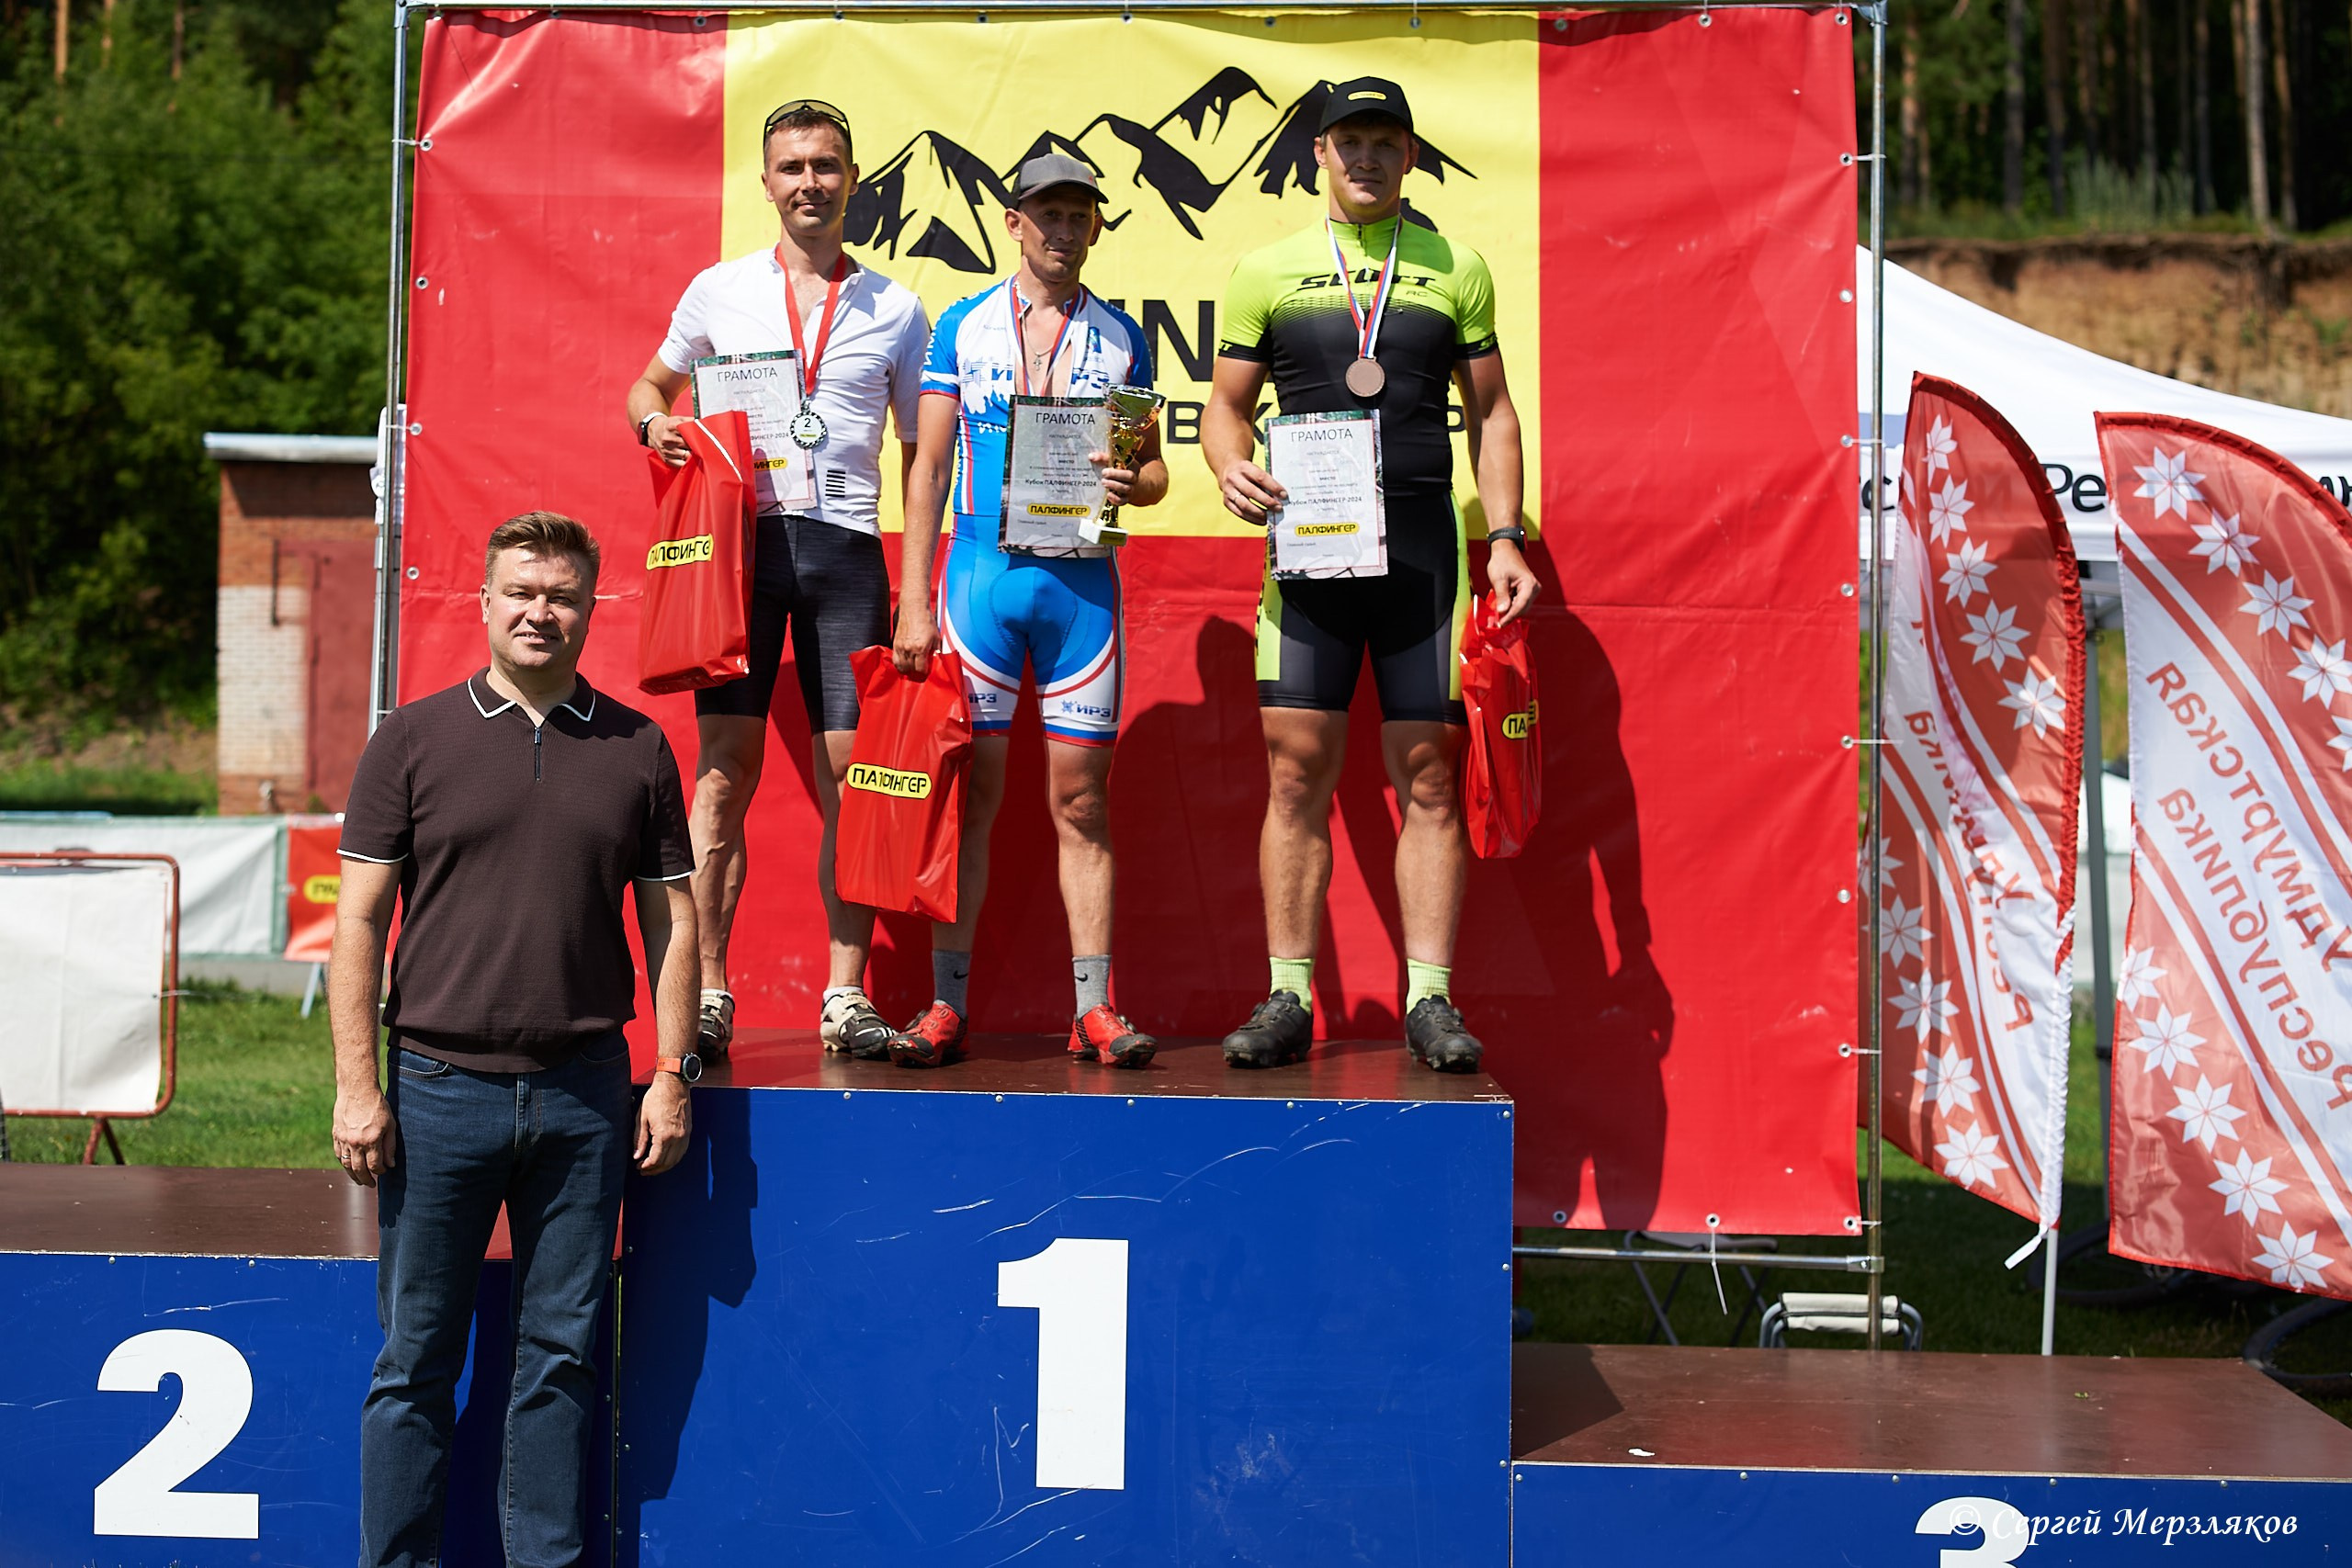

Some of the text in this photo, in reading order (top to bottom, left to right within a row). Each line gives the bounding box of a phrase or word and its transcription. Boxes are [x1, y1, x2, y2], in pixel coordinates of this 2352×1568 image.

[718, 367, 777, 382] ГРАМОТА
[804, 417, 811, 428] 2
[1035, 412, 1096, 425] ГРАМОТА
[1291, 428, 1353, 443] ГРАМОТА
[1030, 505, 1088, 515] ПАЛФИНГЕР
[1297, 524, 1356, 535] ПАЛФИНГЕР
[1077, 704, 1112, 718] ИРЗ
[998, 1237, 1129, 1490] 1
[94, 1328, 259, 1540] 2
